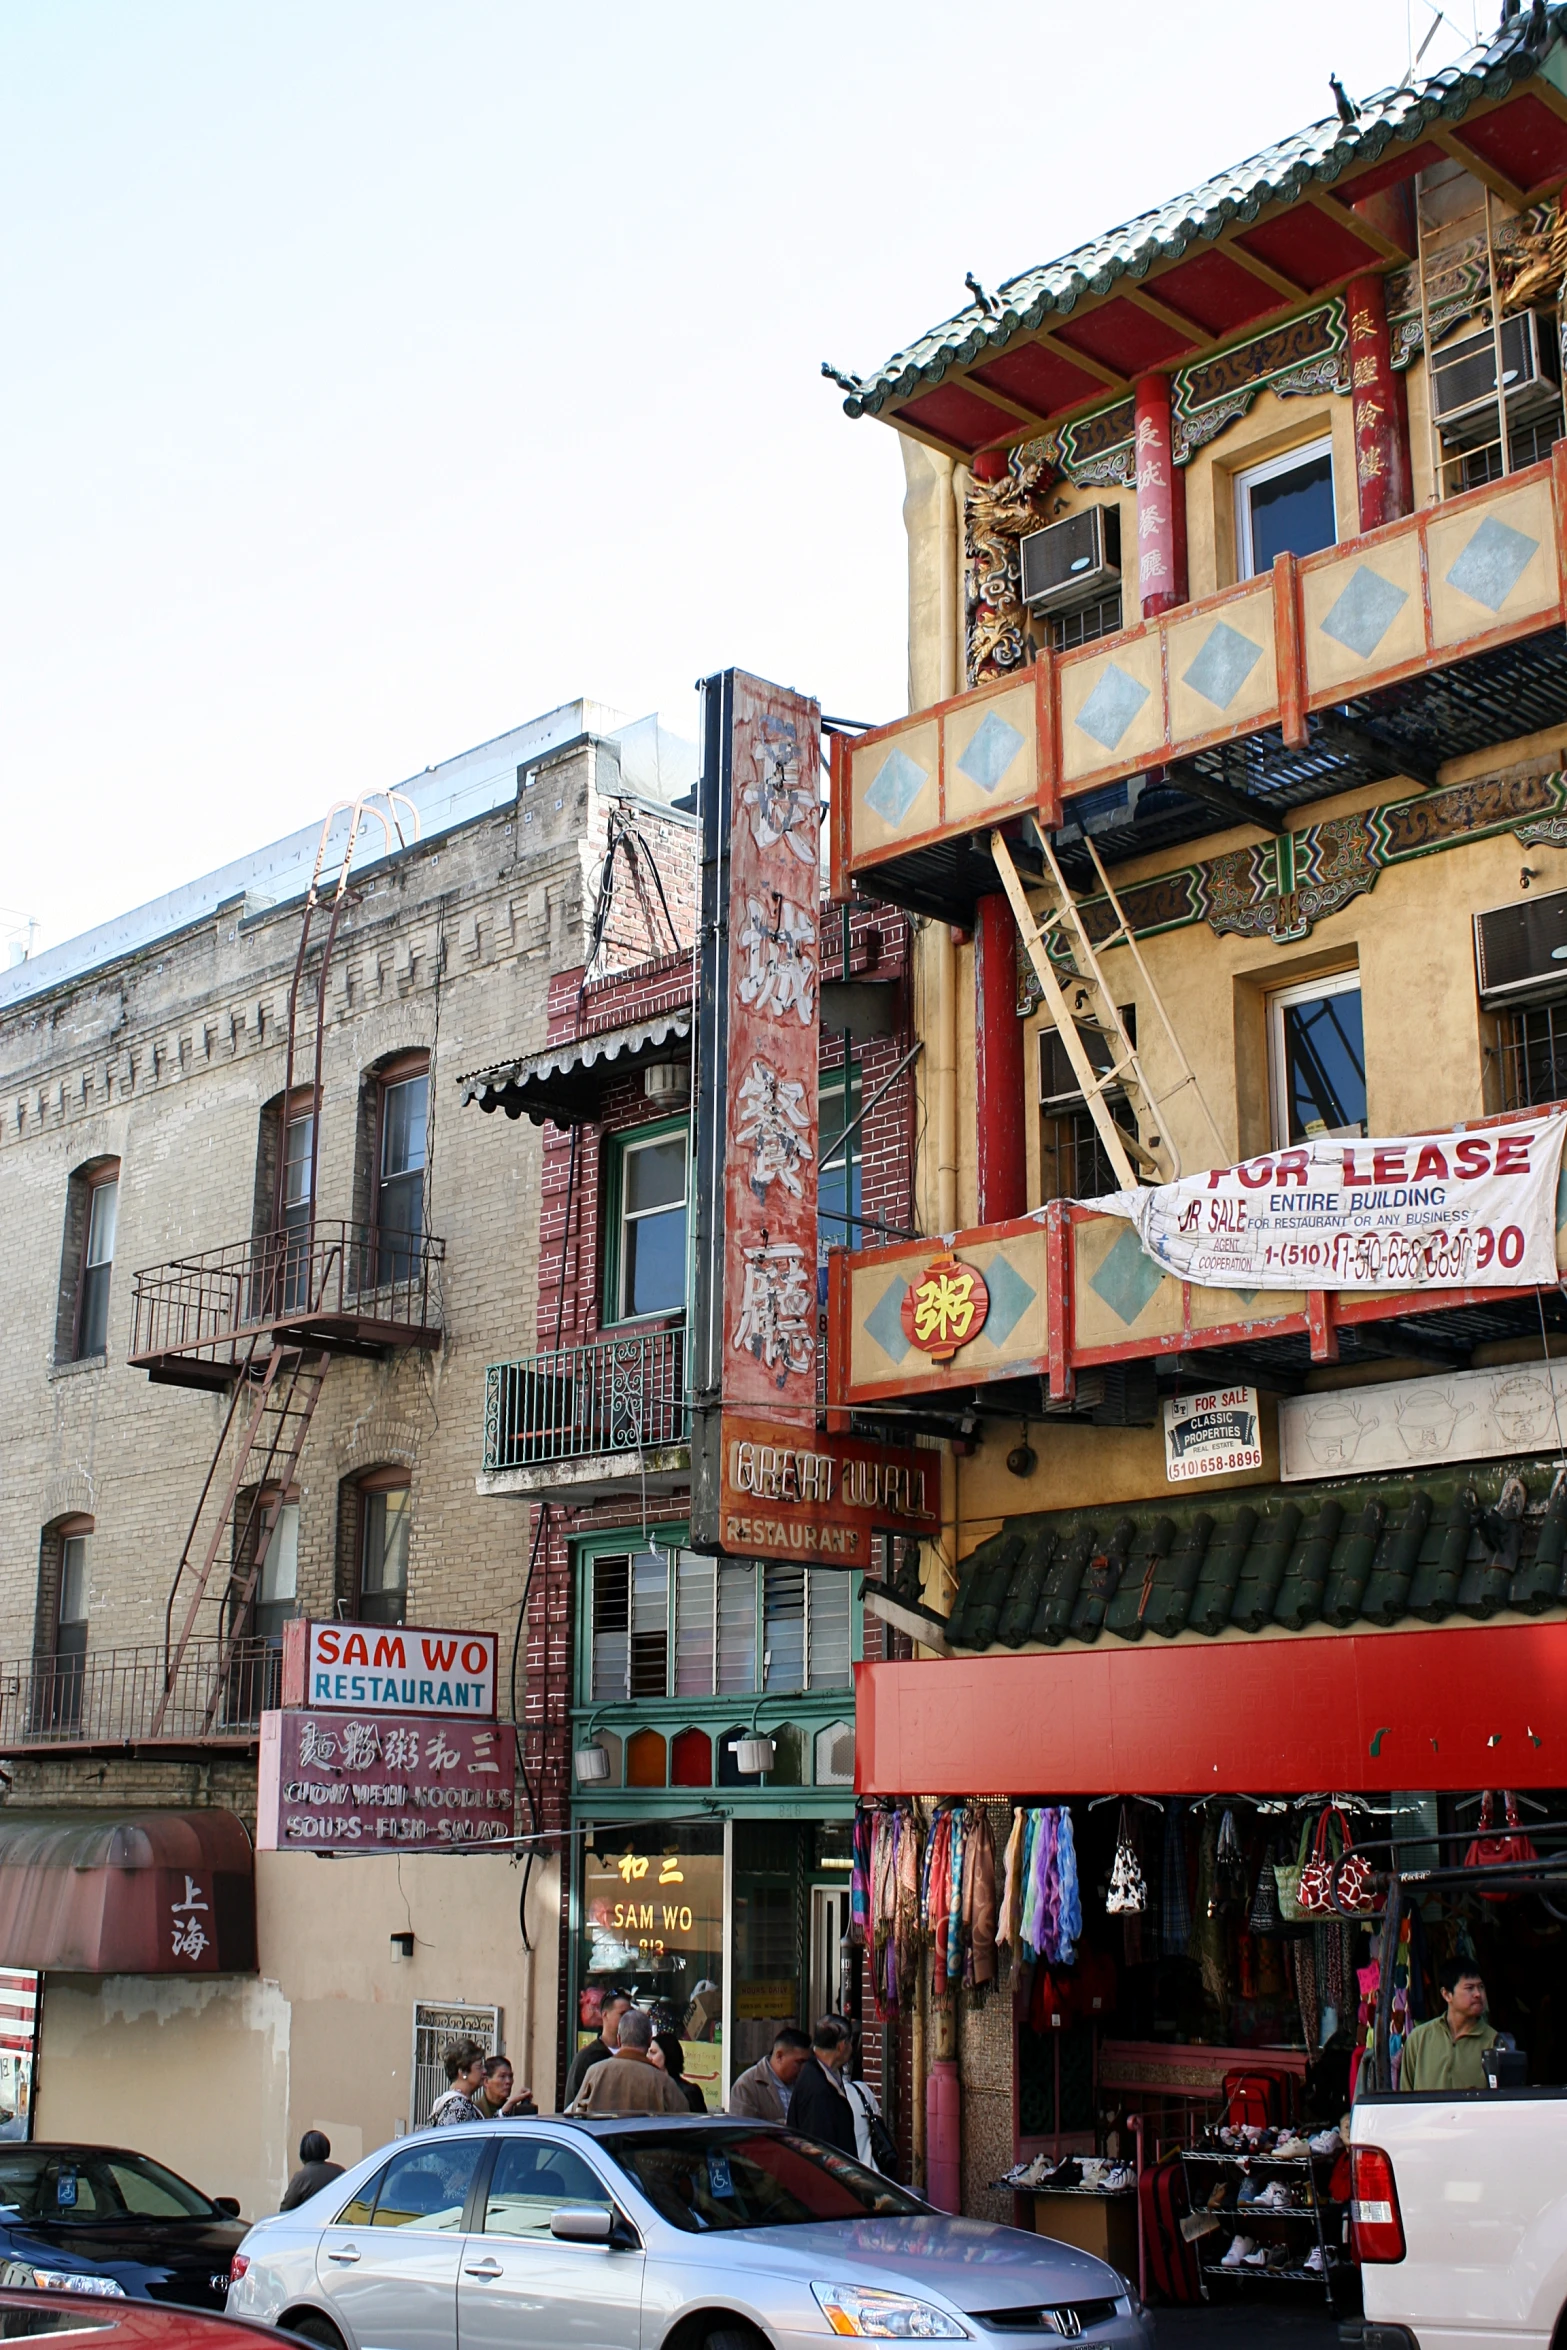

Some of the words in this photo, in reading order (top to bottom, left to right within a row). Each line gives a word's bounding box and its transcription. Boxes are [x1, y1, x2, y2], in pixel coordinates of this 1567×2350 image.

[1342, 1134, 1536, 1187] LEASE
[1270, 1193, 1340, 1212] ENTIRE
[1350, 1186, 1446, 1211] BUILDING
[1207, 1198, 1248, 1234] SALE
[1247, 1219, 1270, 1230] FOR
[1274, 1215, 1348, 1229] RESTAURANT
[1353, 1215, 1372, 1227] OR
[1377, 1213, 1401, 1226] ANY
[1405, 1209, 1470, 1225] BUSINESS
[1213, 1238, 1241, 1252] AGENT
[1198, 1256, 1253, 1272] COOPERATION
[914, 1273, 976, 1341] 粥
[1195, 1395, 1217, 1413] FOR
[1220, 1387, 1249, 1408] SALE
[1190, 1411, 1233, 1430] CLASSIC
[1184, 1425, 1241, 1447] PROPERTIES
[1192, 1444, 1210, 1454] REAL
[1211, 1440, 1235, 1451] ESTATE
[729, 1440, 836, 1502] GREAT
[726, 1516, 859, 1554] RESTAURANT
[316, 1629, 407, 1669] SAM
[421, 1638, 488, 1675] WO
[315, 1673, 486, 1708] RESTAURANT
[284, 1781, 349, 1806] CHOW
[171, 1874, 210, 1962] 上海
[613, 1903, 654, 1930] SAM
[662, 1905, 693, 1931] WO
